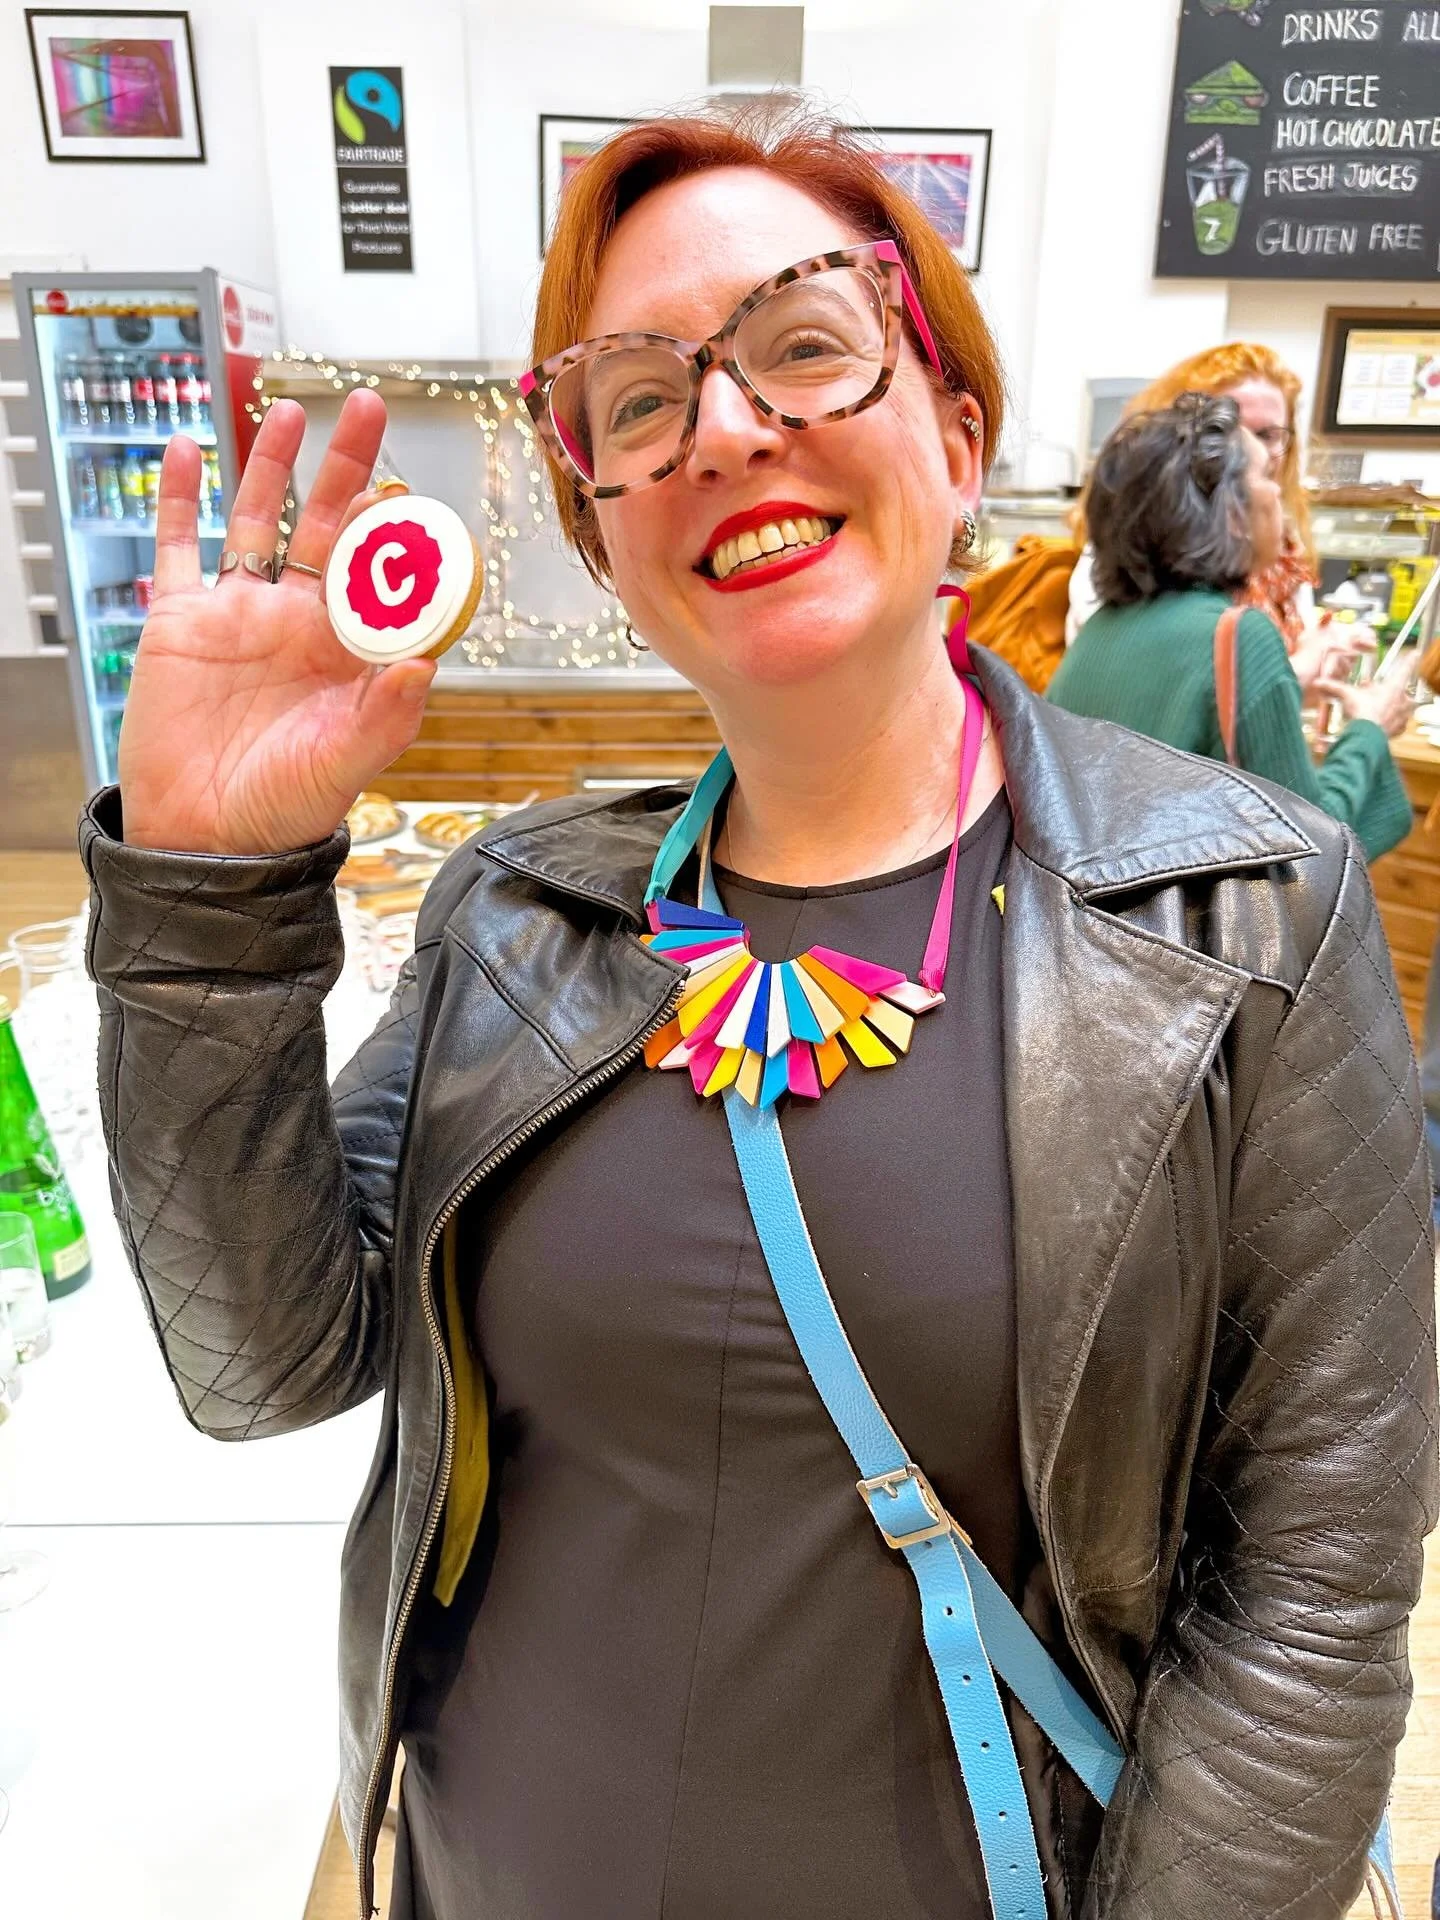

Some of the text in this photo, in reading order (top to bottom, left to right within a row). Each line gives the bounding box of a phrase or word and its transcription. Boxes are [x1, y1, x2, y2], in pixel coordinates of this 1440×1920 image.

[1282, 9, 1380, 48] DRINKS
[1283, 72, 1380, 107] COFFEE
[1277, 116, 1440, 149] HOT CHOCOLATE
[336, 146, 405, 163] FAIRTRADE
[1264, 161, 1417, 197] FRESH JUICES
[1256, 218, 1424, 255] GLUTEN FREE
[370, 541, 416, 607] C
